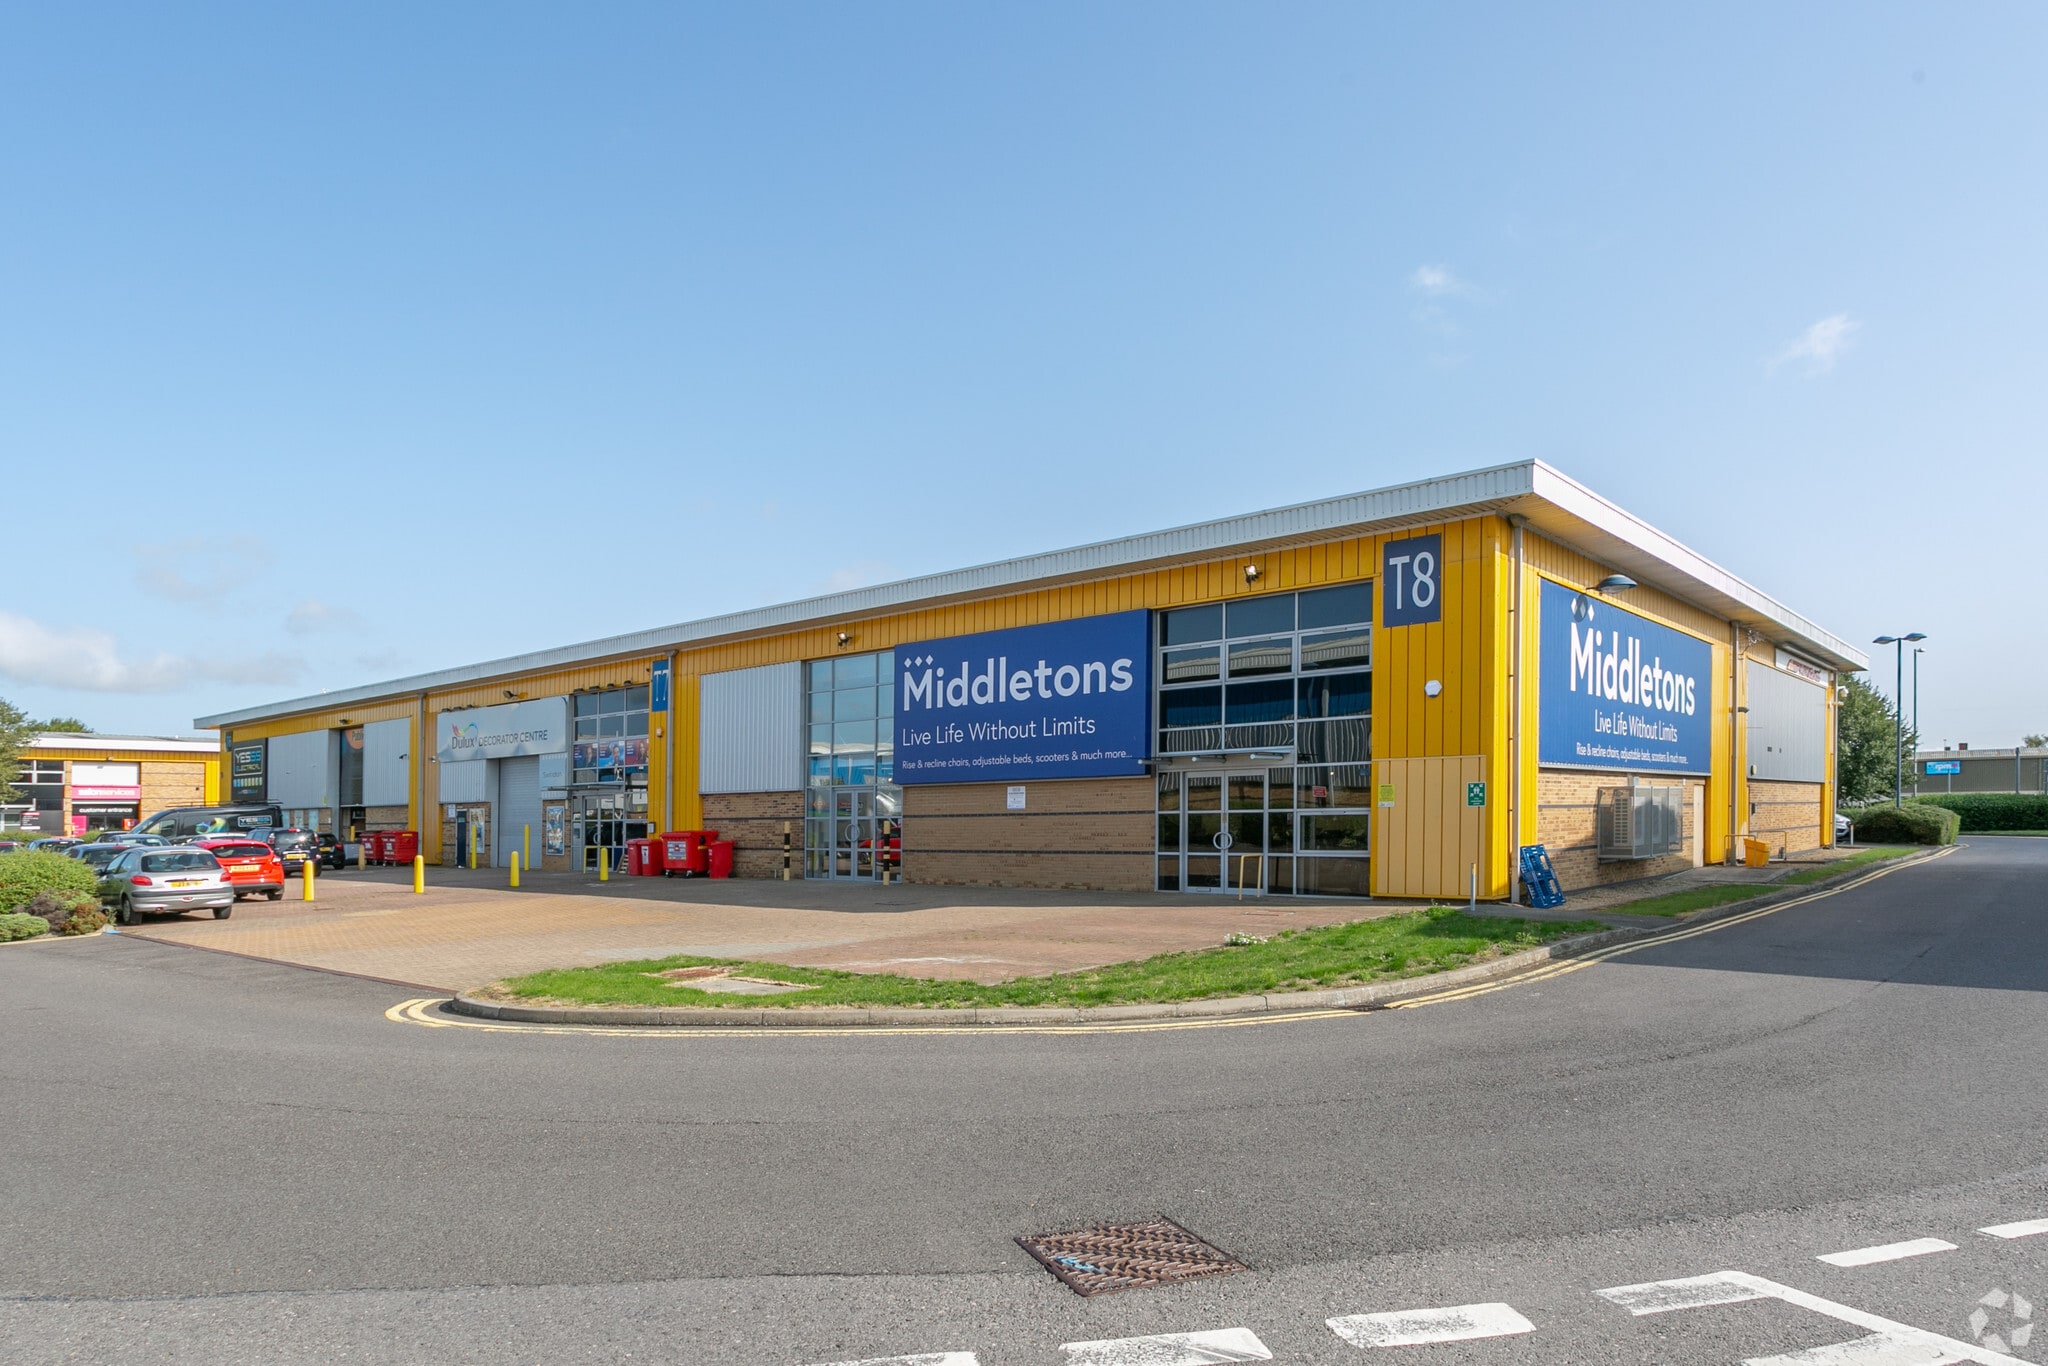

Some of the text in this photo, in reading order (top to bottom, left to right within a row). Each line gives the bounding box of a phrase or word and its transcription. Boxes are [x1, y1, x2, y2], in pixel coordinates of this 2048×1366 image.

[1389, 551, 1435, 610] T8
[903, 656, 1134, 711] Middletons
[1570, 622, 1696, 716] Middletons
[653, 669, 670, 702] T7
[452, 730, 548, 749] Dulux DECORATOR CENTRE
[902, 715, 1096, 746] Live Life Without Limits
[1594, 709, 1678, 742] Live Life Without Limits
[235, 751, 262, 763] YESSS
[902, 760, 915, 769] Rise
[917, 760, 923, 769] &
[924, 759, 946, 768] recline
[948, 758, 970, 768] chairs,
[972, 755, 1011, 768] adjustable
[1013, 753, 1034, 764] beds,
[1035, 753, 1069, 763] scooters
[1071, 750, 1078, 760] &
[1080, 749, 1103, 760] much
[1576, 742, 1586, 756] Rise
